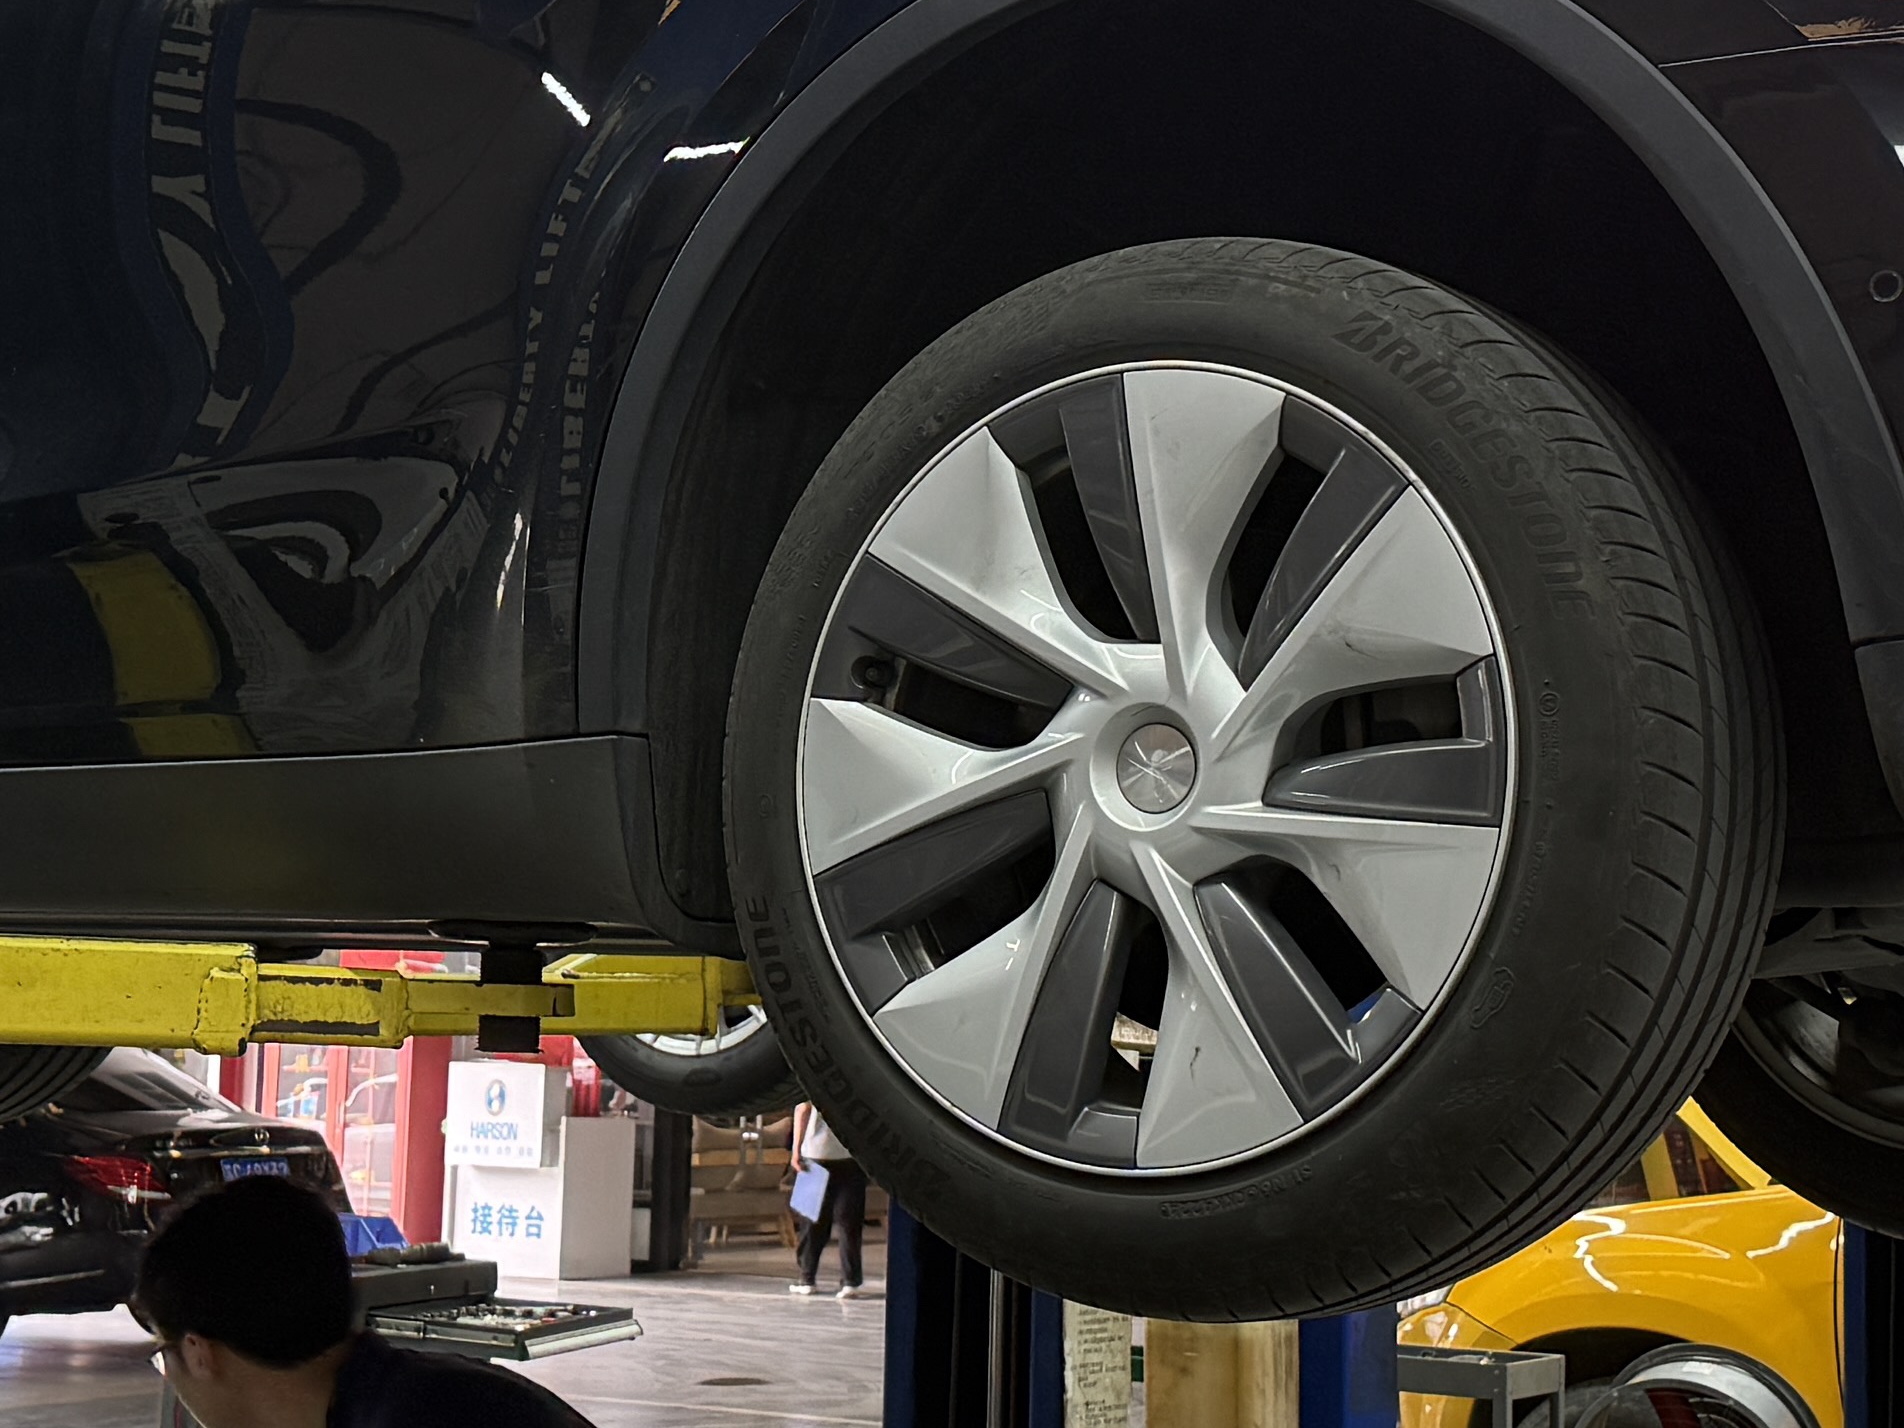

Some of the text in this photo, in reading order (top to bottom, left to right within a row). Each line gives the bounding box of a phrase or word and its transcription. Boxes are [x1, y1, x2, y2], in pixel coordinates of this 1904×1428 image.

[1331, 310, 1596, 620] BRIDGESTONE
[470, 1121, 518, 1141] HARSON
[471, 1202, 544, 1240] 接待台
